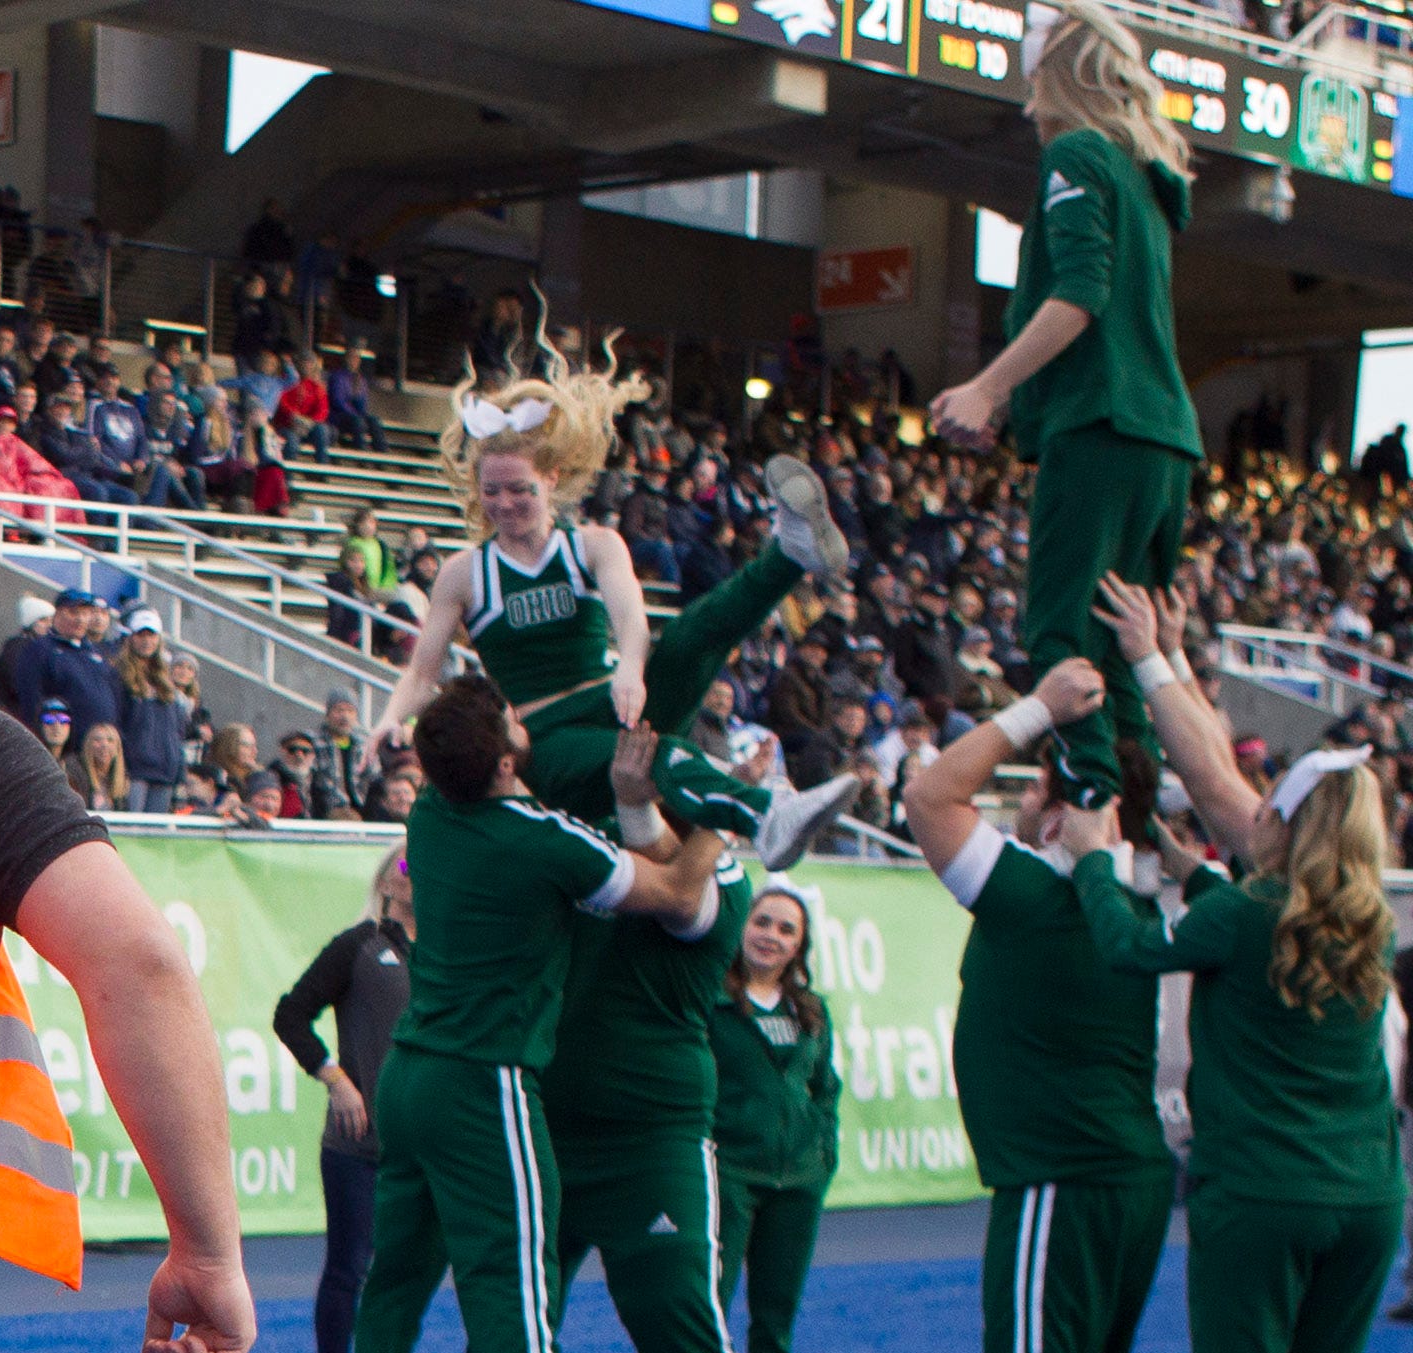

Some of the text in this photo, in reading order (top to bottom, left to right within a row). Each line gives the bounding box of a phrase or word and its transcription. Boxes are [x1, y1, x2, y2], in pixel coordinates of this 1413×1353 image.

[856, 0, 904, 45] 21
[958, 0, 1024, 42] DOWN
[977, 40, 1009, 81] 10
[1149, 49, 1188, 84] 4TH
[1192, 92, 1227, 134] 20
[1240, 76, 1291, 139] 30
[506, 582, 578, 629] OHIO
[859, 1126, 969, 1173] UNION
